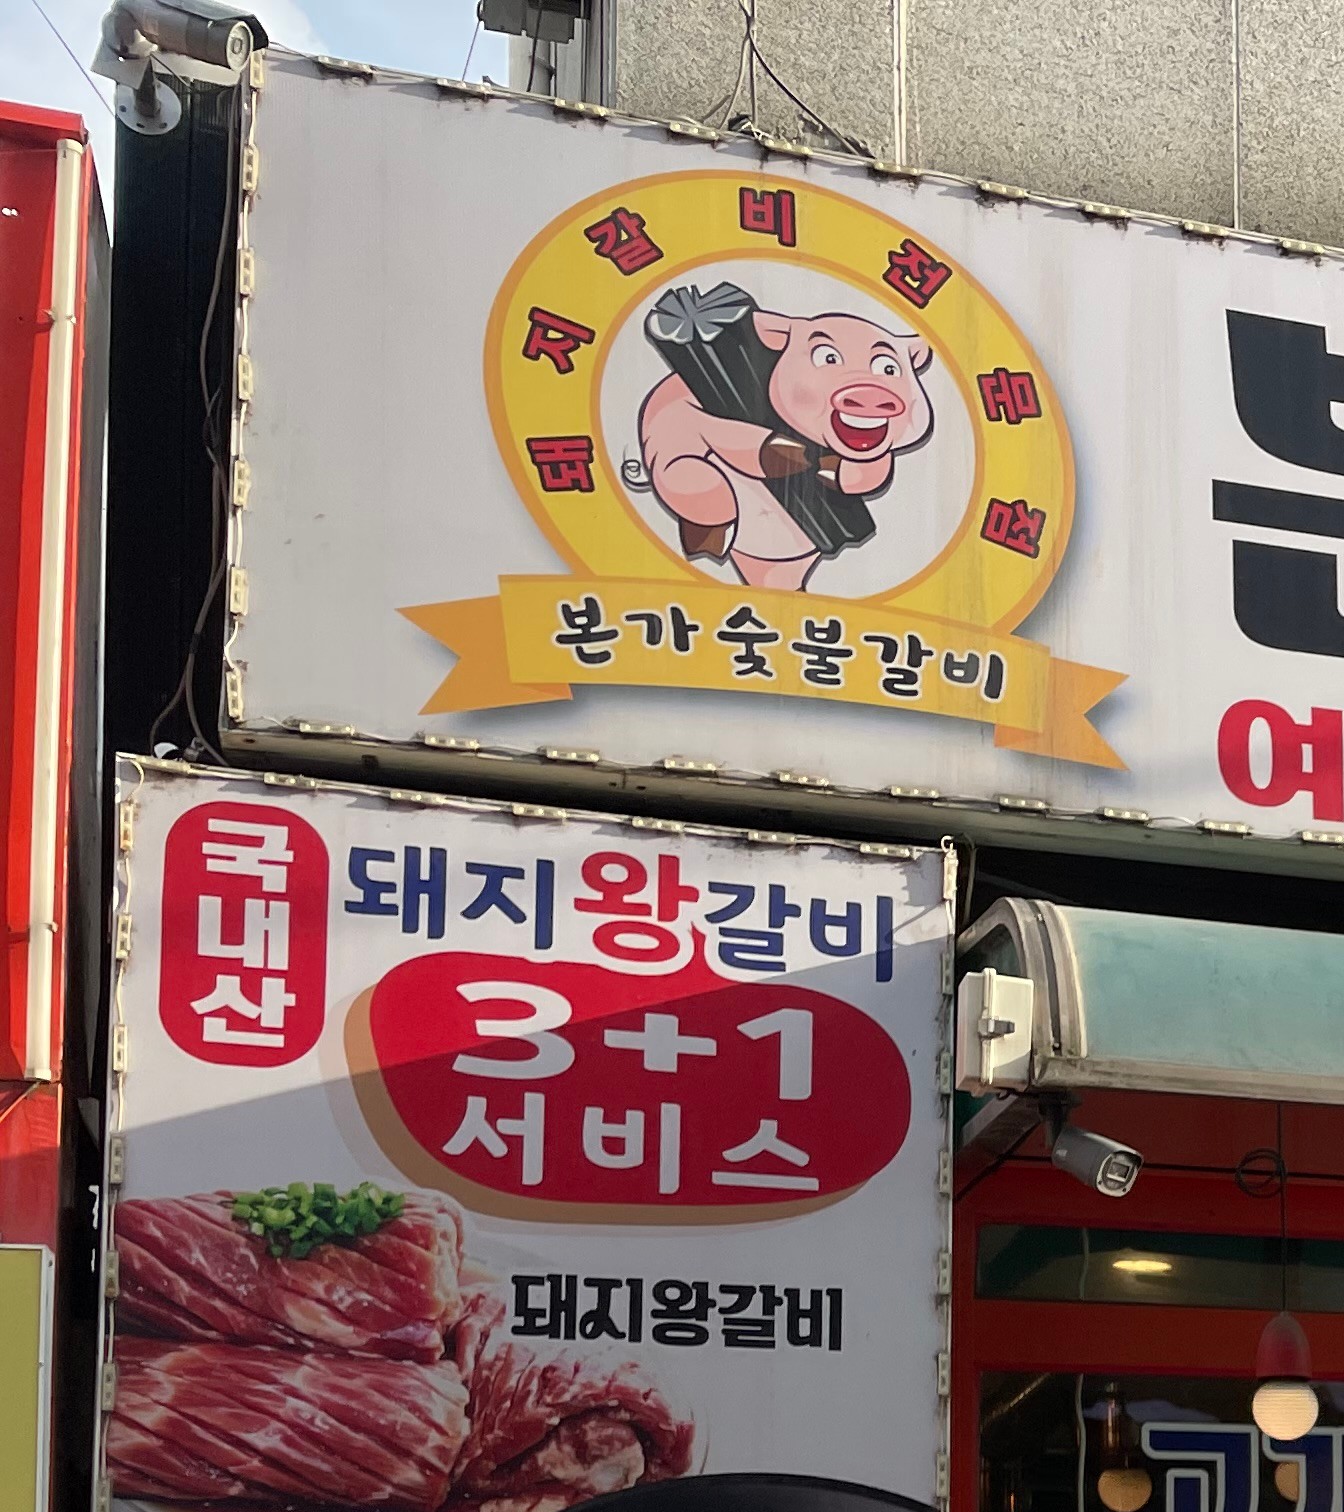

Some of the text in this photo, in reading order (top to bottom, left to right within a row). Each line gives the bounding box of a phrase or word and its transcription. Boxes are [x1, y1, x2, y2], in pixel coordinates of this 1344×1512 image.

[190, 817, 298, 1049] 국내산
[344, 845, 894, 984] 돼지왕갈비
[451, 980, 815, 1101] 3+1
[442, 1092, 821, 1194] 서비스
[510, 1273, 845, 1352] 돼지왕갈비
